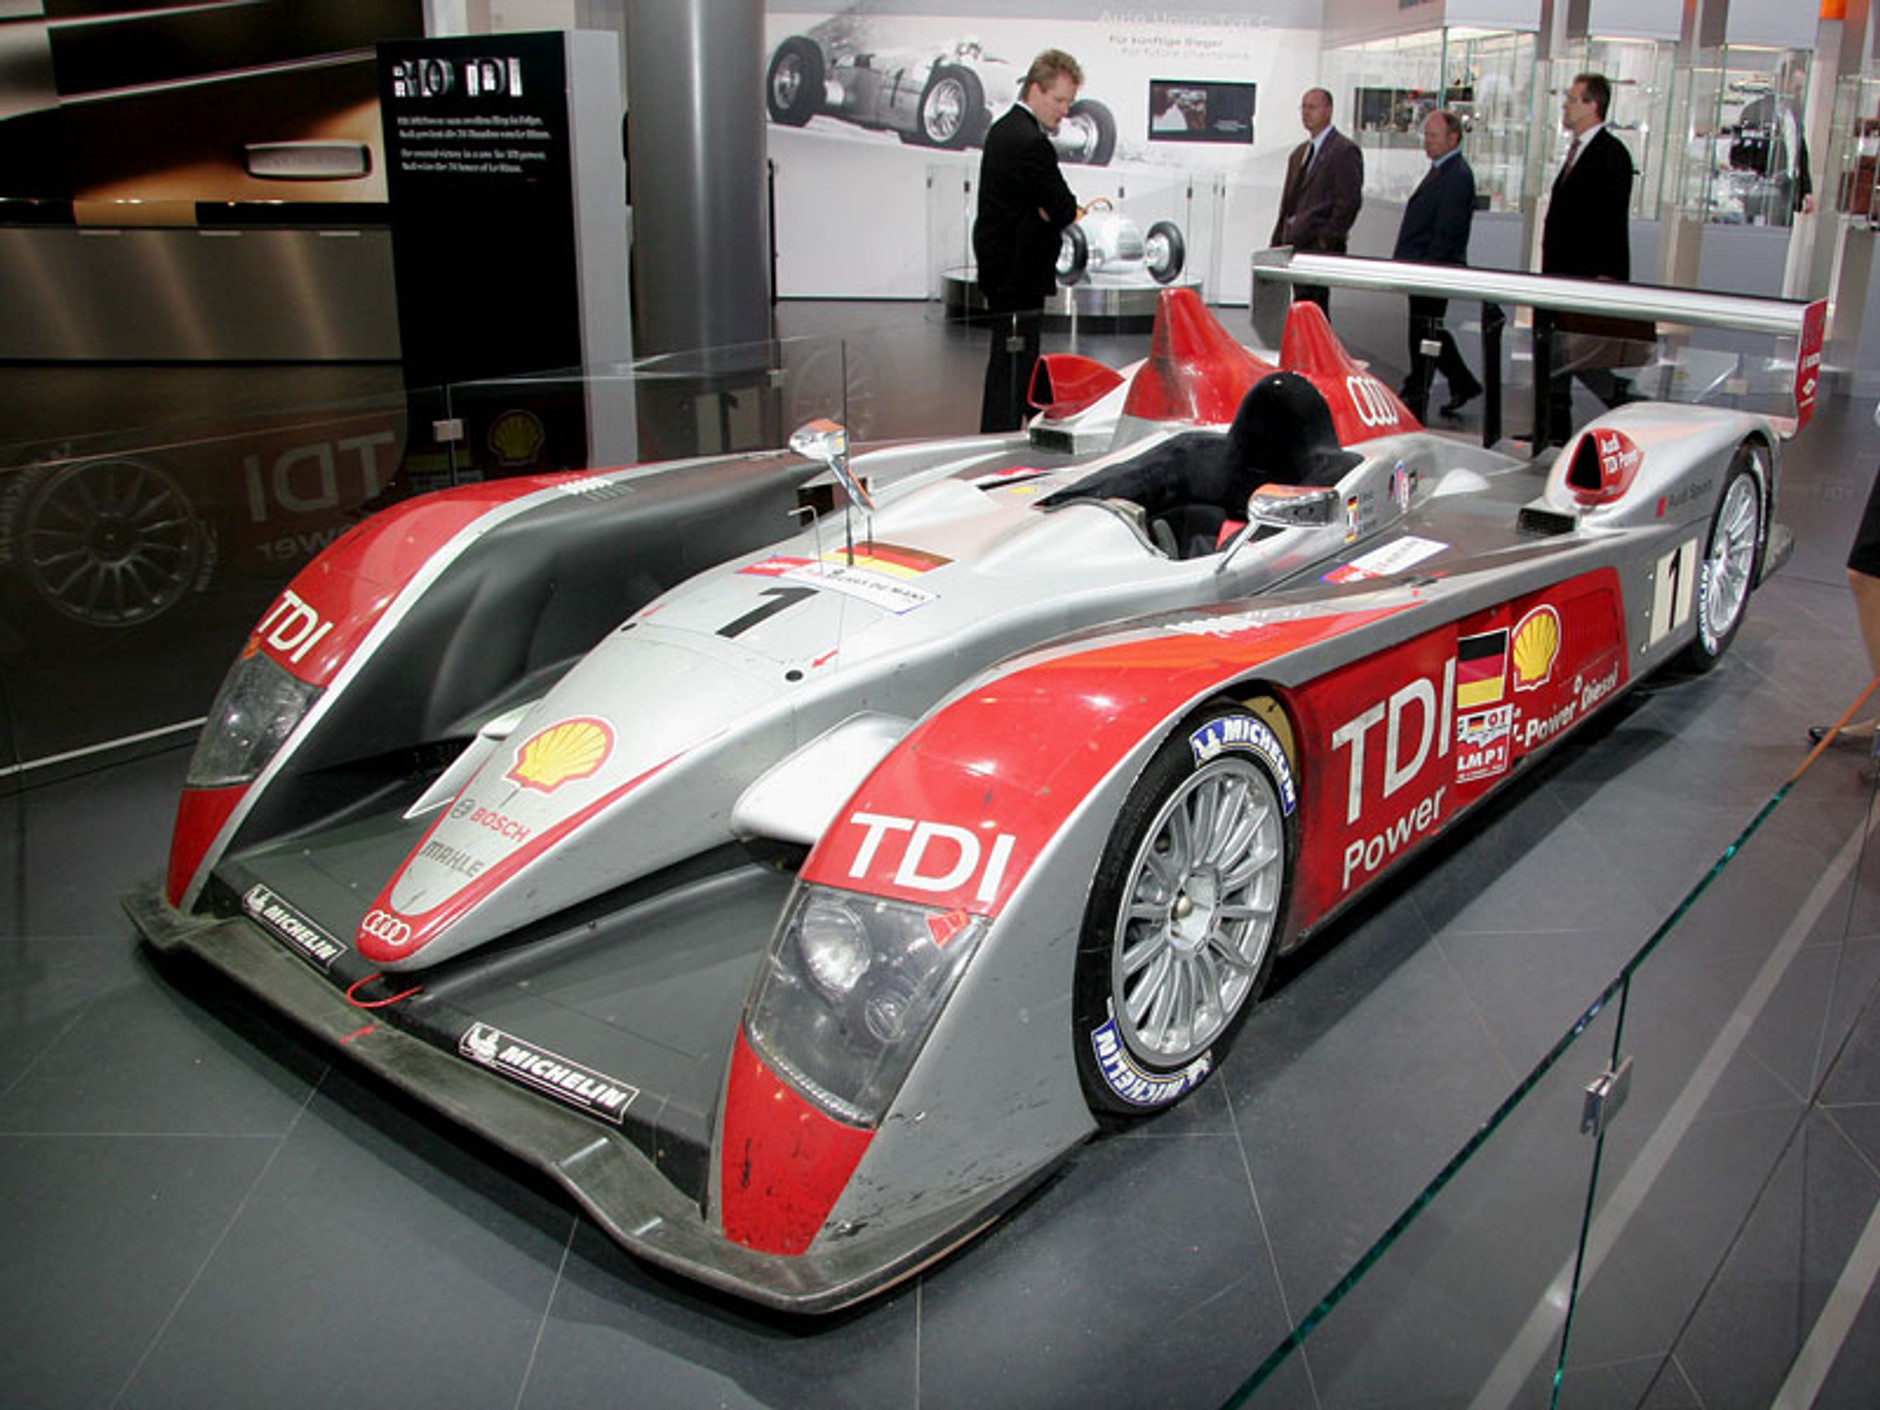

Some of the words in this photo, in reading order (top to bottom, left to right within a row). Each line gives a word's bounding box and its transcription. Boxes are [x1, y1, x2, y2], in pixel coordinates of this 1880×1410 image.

[465, 57, 522, 97] TDI
[714, 586, 821, 639] 1
[1668, 546, 1681, 631] 1
[257, 589, 334, 664] TDI
[1332, 656, 1456, 826] TDI
[469, 806, 532, 843] BOSCH
[1342, 785, 1447, 891] Power
[420, 841, 486, 878] MAHLE
[848, 812, 1017, 905] TDI
[263, 903, 339, 961] MICHELIN
[499, 1045, 628, 1109] MICHELIN
